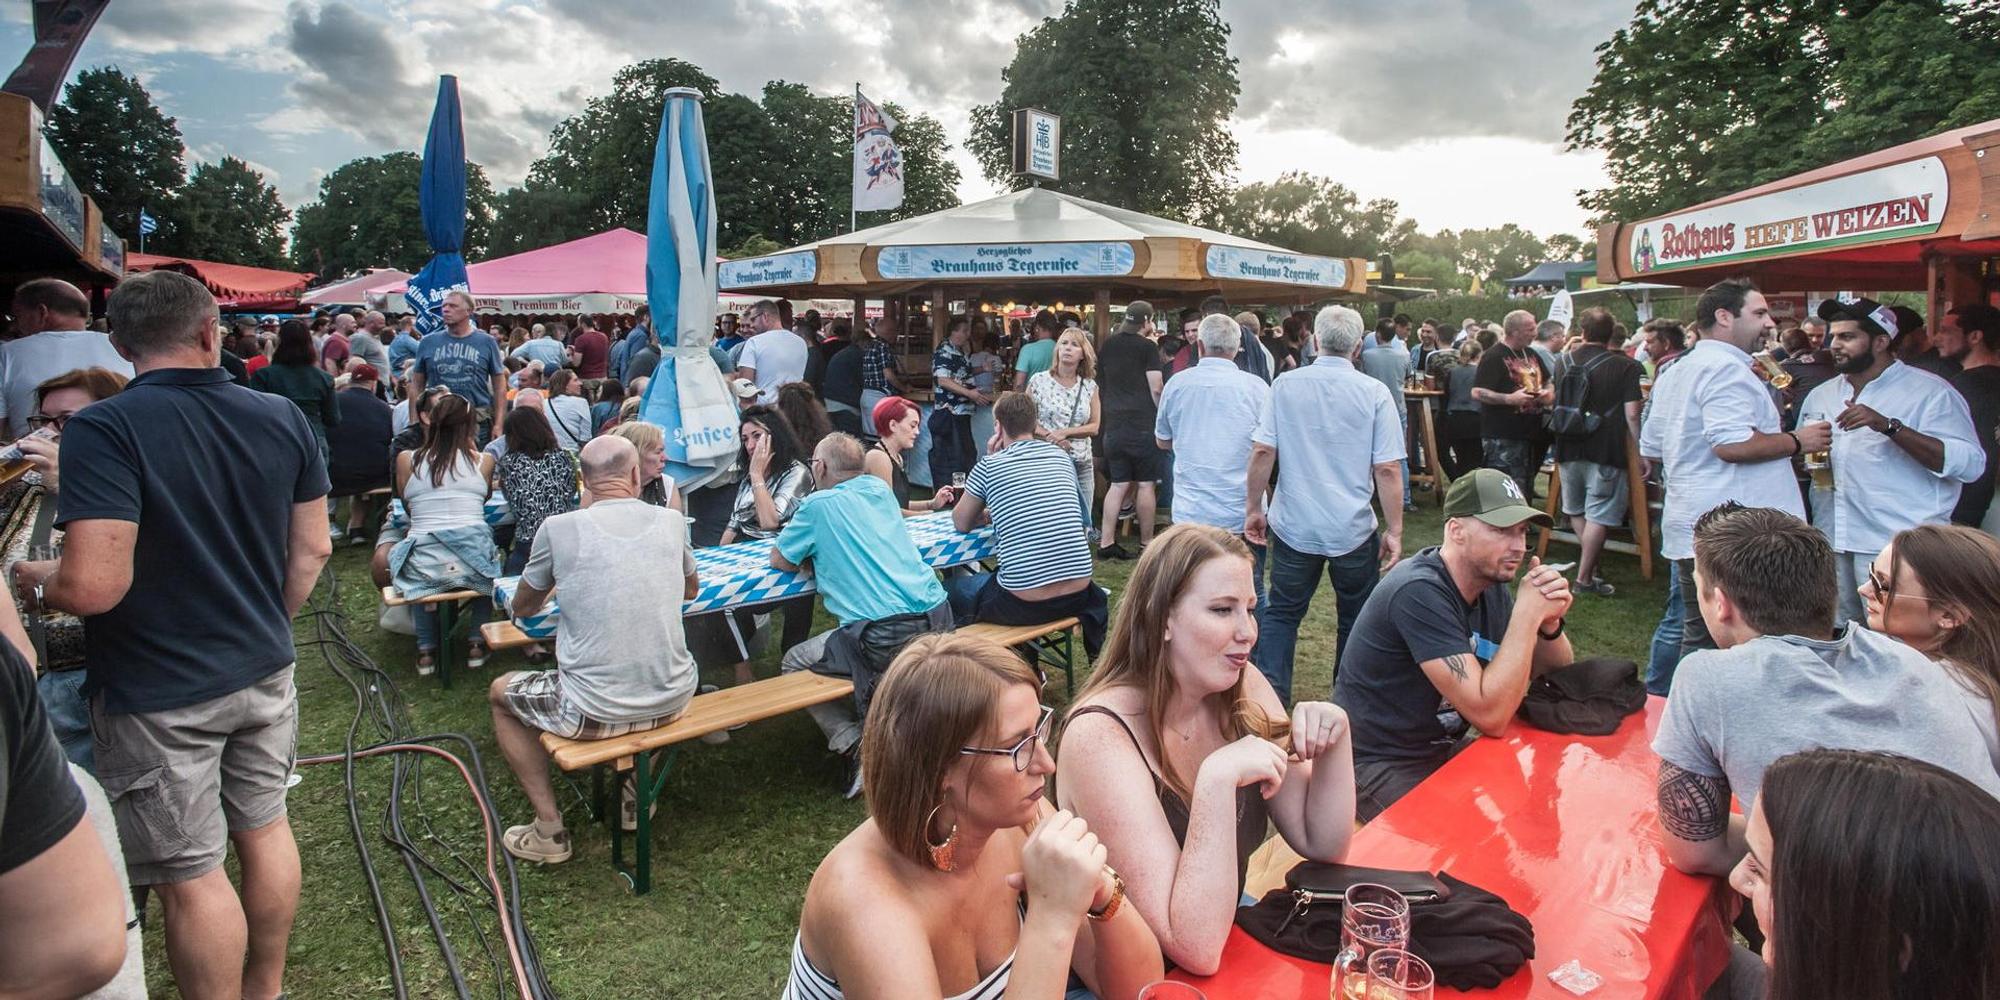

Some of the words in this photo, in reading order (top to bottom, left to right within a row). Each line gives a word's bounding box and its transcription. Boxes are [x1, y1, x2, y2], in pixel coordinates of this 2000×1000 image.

[1661, 221, 1735, 261] Rothaus
[1744, 217, 1808, 249] HEFE
[1812, 193, 1933, 239] WEIZEN
[977, 246, 1032, 257] Herzogliches
[931, 258, 1003, 274] Brauhaus
[513, 301, 558, 310] Premium
[562, 300, 582, 310] Bier
[434, 343, 480, 364] GASOLINE
